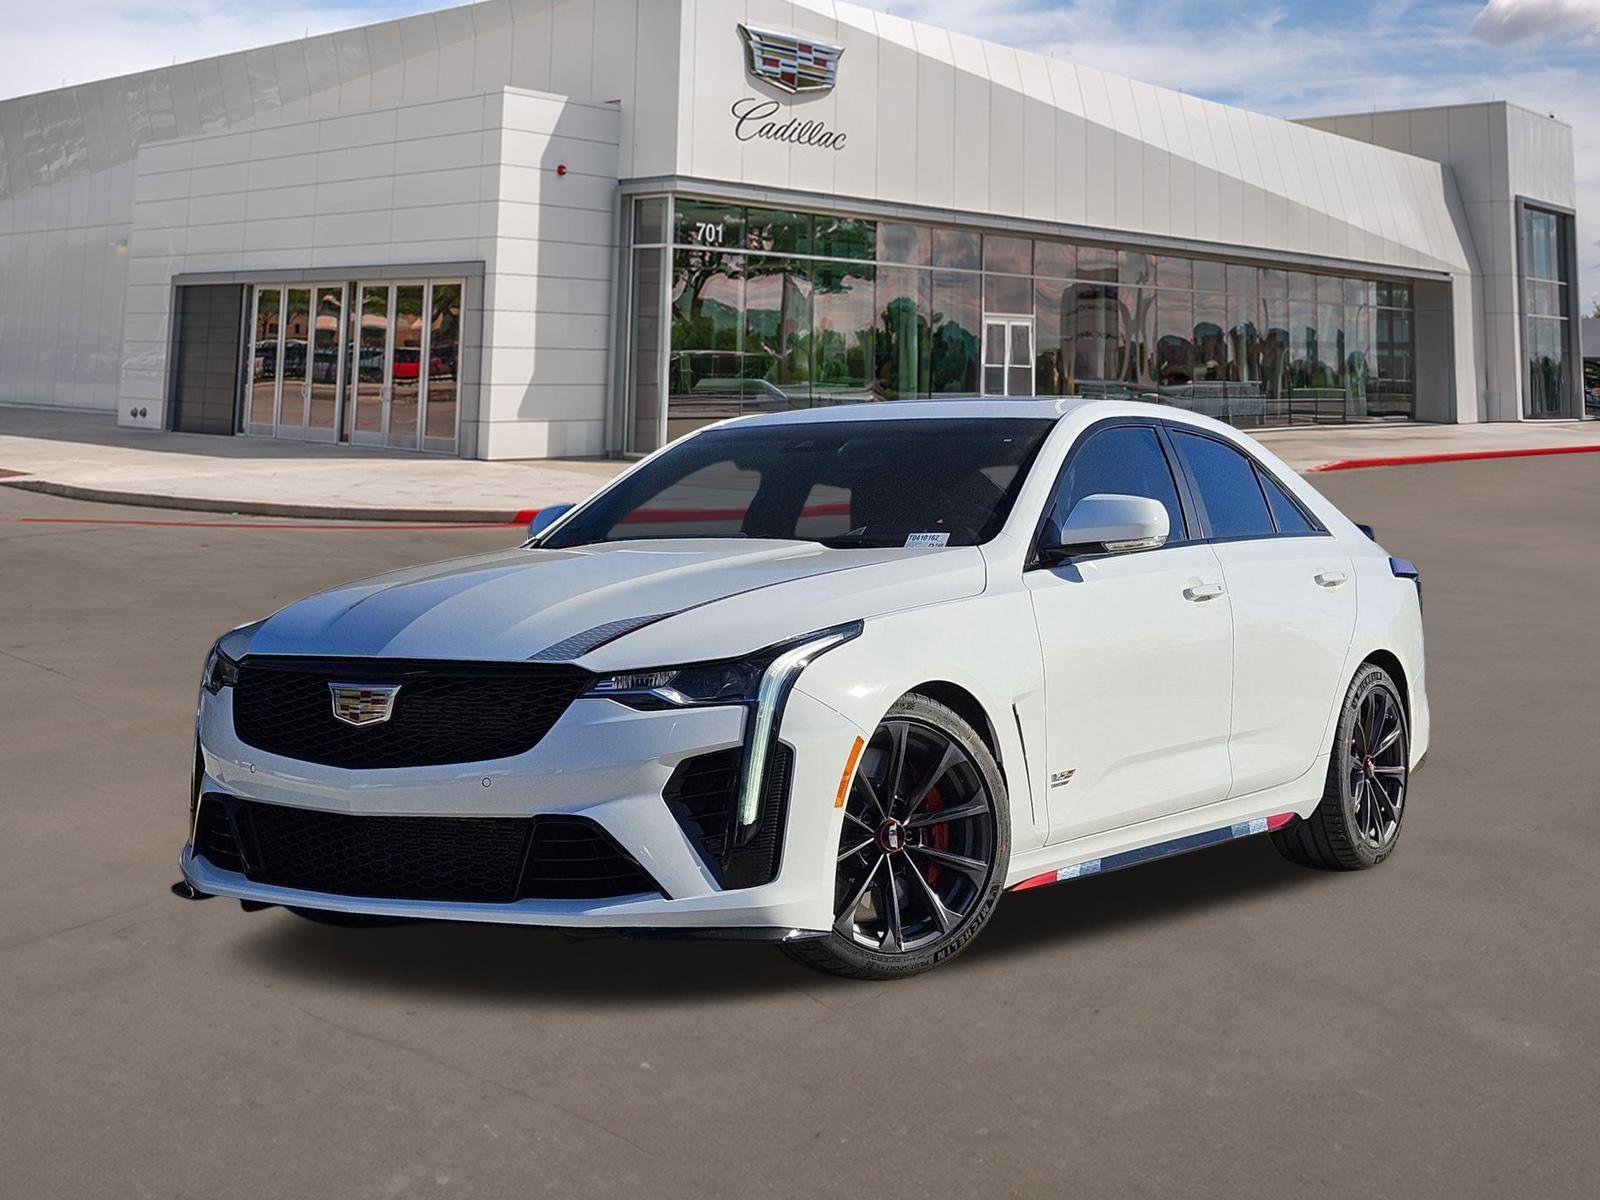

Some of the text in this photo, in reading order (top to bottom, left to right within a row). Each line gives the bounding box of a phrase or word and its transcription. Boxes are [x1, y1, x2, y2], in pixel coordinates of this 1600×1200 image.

[731, 97, 847, 151] Cadillac
[696, 222, 724, 243] 701
[937, 903, 990, 960] MICHELIN
